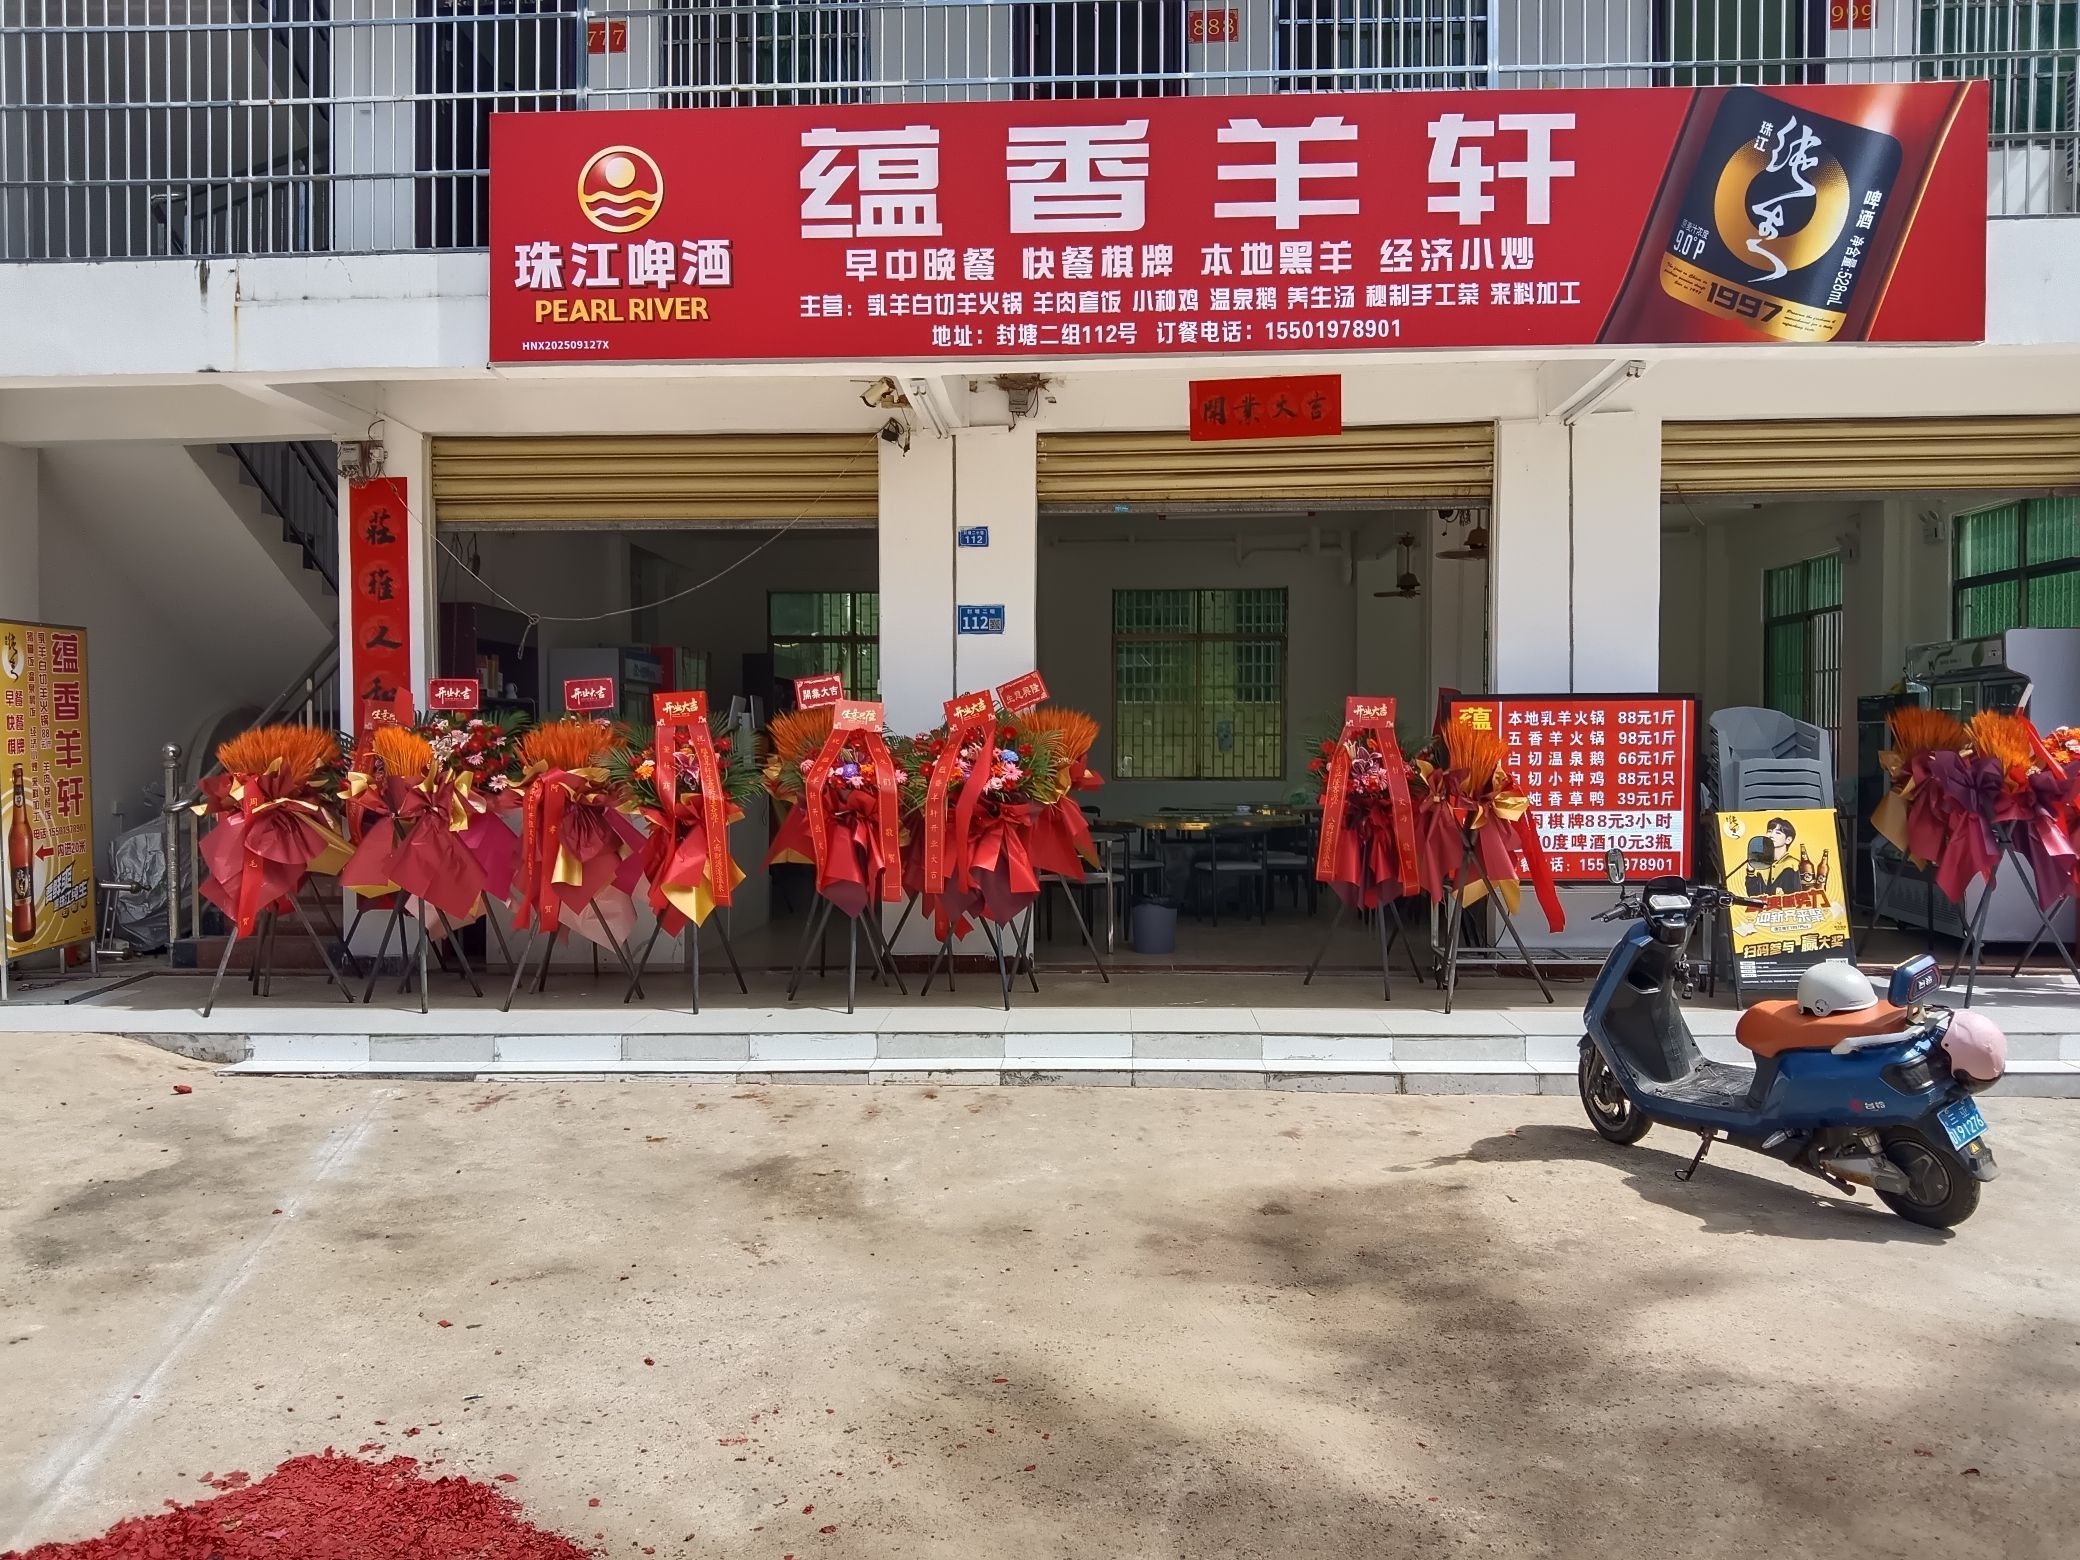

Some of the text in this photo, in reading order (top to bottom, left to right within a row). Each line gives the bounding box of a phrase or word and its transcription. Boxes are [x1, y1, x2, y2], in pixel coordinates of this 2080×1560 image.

[1831, 4, 1873, 23] 999
[1193, 18, 1235, 36] 888
[1754, 120, 1774, 152] 珠江
[800, 112, 1576, 239] 蕴香羊轩
[513, 238, 733, 290] 珠江啤酒
[845, 236, 1535, 283] 早中晚餐 快餐棋牌 本地黑羊 经济小炒
[1033, 289, 1122, 315] 羊肉套饭
[1133, 288, 1199, 312] 小种鸡
[1210, 286, 1277, 311] 温泉鹅
[1287, 285, 1355, 310] 养生汤
[1366, 282, 1479, 307] 秘制手工菜
[1490, 281, 1581, 305] 来料加工
[1706, 281, 1784, 324] 1997
[535, 296, 710, 324] PEARL RIVER
[522, 340, 609, 351] HNX202509127X
[965, 535, 983, 544] 112
[962, 616, 989, 630] 112
[435, 686, 472, 705] 开业大吉
[571, 684, 606, 705] 开业大吉
[663, 698, 699, 719] 开业大吉
[953, 697, 987, 723] 开业大吉
[1353, 704, 1388, 723] 开业大吉
[1508, 710, 1676, 726] 本地乳羊火锅 88元1斤
[1508, 731, 1677, 746] 五香羊火锅 98元1斤
[1508, 751, 1676, 767] 白切温泉鹅 66元1斤
[1617, 771, 1675, 785] 88元1只
[1617, 791, 1675, 807] 39元1斤
[1538, 833, 1673, 850] 0度啤酒10元3瓶
[1743, 934, 1844, 959] 扫码参与 赢大奖
